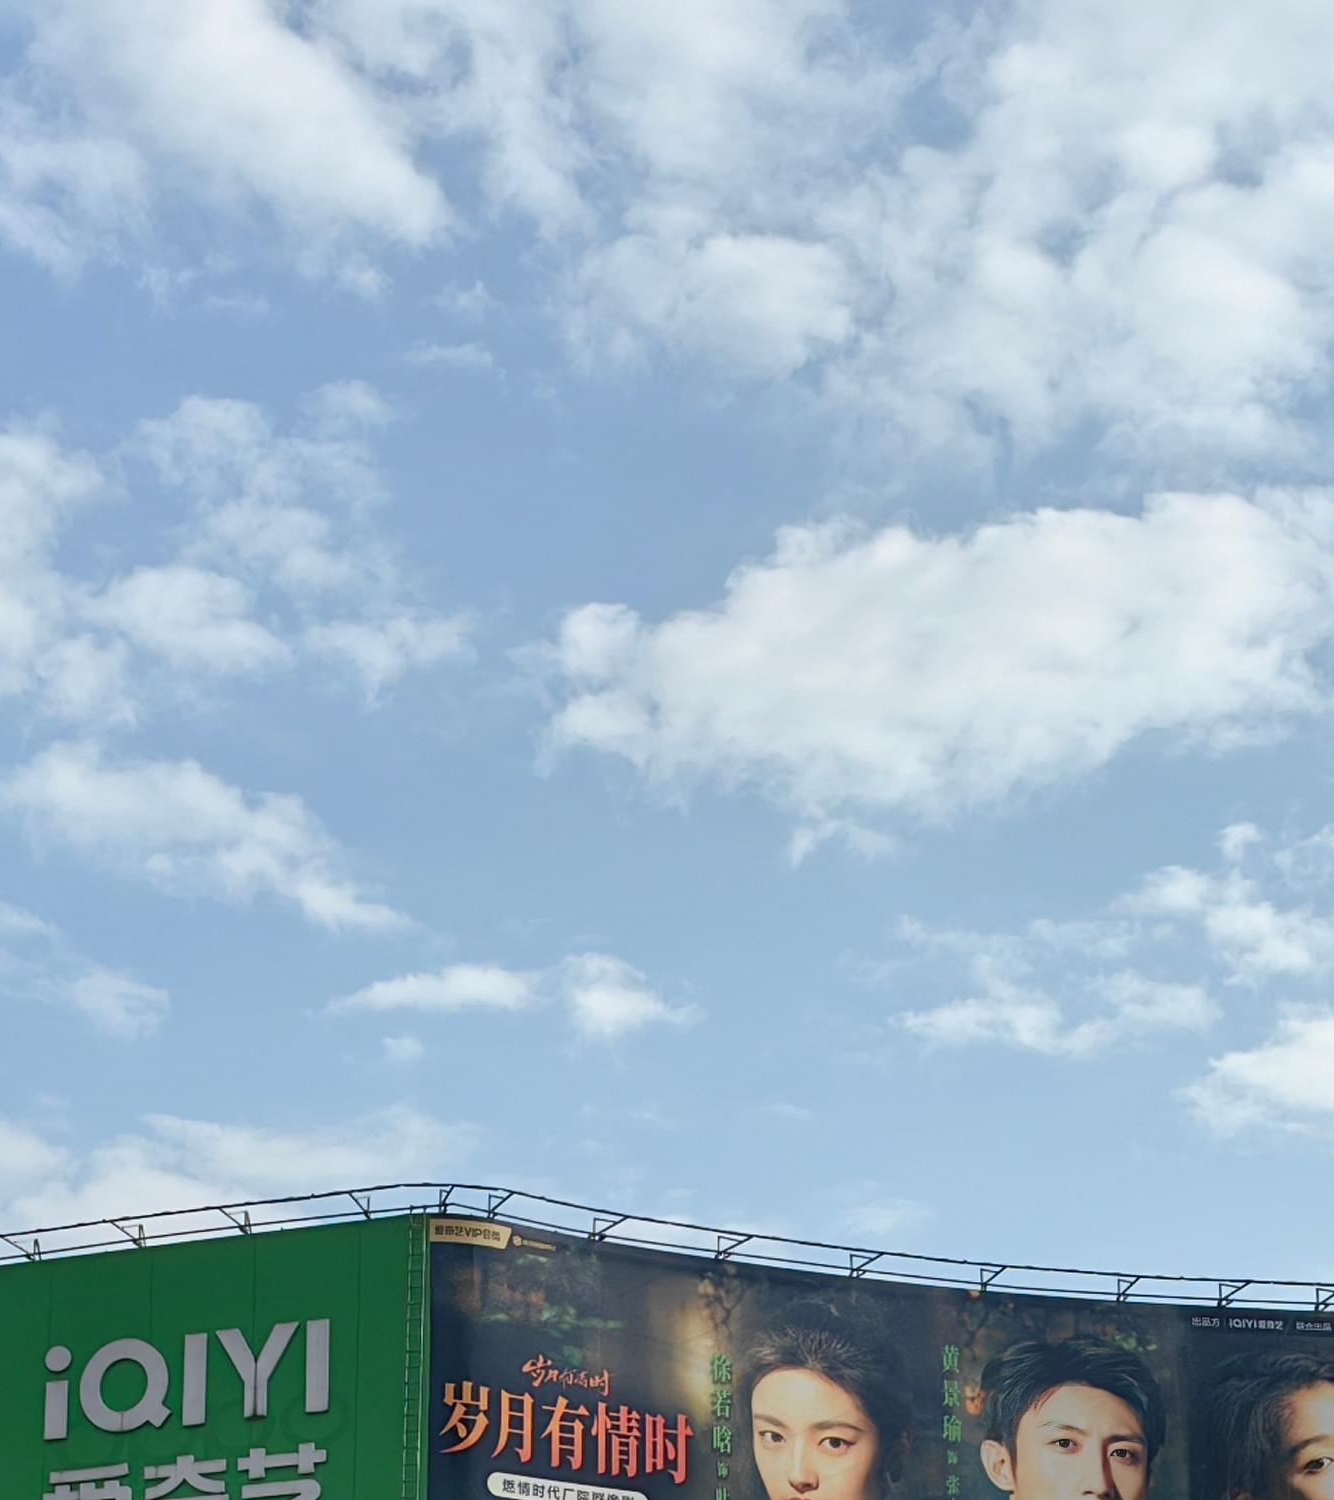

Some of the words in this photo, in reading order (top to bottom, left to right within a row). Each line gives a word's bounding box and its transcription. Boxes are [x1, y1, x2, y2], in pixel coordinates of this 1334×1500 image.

[43, 1319, 330, 1441] iQIYI
[439, 1381, 695, 1484] 岁月有情时
